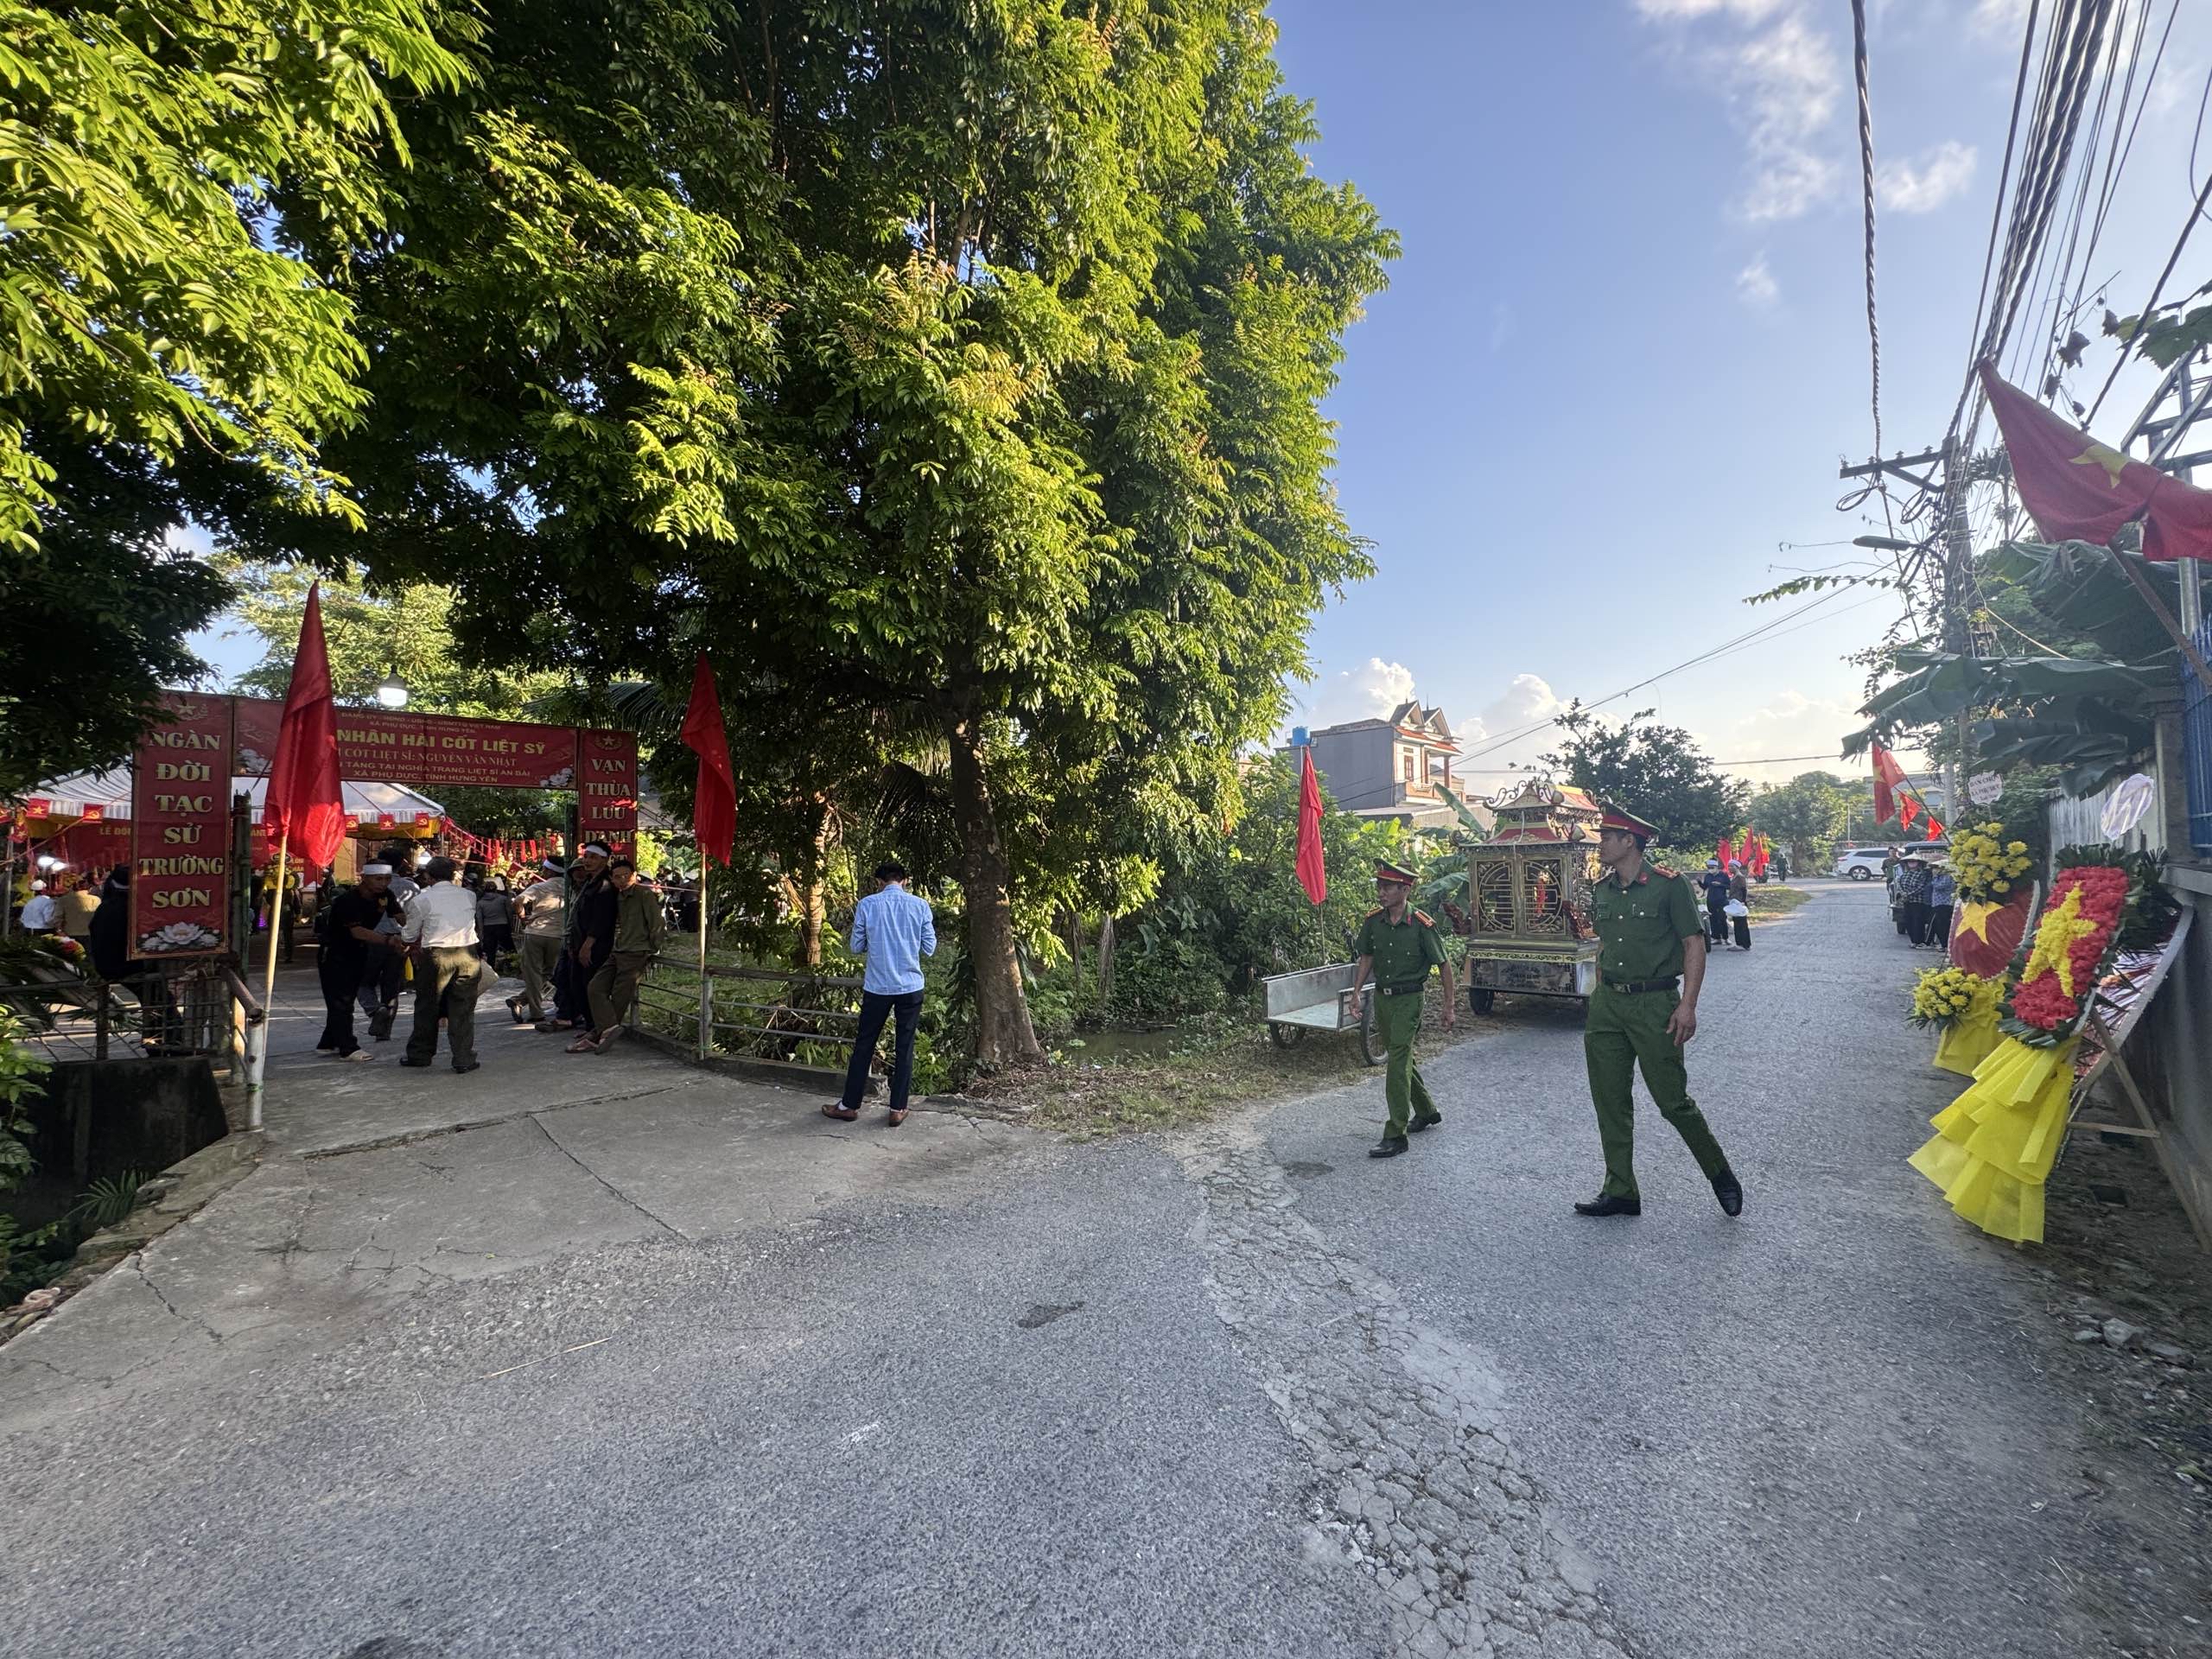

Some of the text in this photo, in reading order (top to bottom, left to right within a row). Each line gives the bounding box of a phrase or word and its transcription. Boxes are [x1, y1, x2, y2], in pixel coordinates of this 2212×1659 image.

[146, 729, 221, 750] NGÀN
[336, 728, 546, 754] NHẬN HÀI CỐT LIỆT SỸ
[346, 747, 372, 759] CỐT
[372, 749, 398, 762] LIỆT
[156, 760, 212, 782] ĐỜI
[345, 760, 375, 769] TÁNG
[380, 763, 395, 772] TẠI
[397, 763, 429, 772] NGHĨA
[591, 759, 626, 774] VẠN
[480, 774, 498, 783] YÊN
[155, 794, 213, 817] TẠC
[592, 804, 626, 820] LƯU
[164, 823, 202, 844] SỬ
[585, 830, 632, 843] DANH
[139, 854, 224, 876] TRƯỜNG
[152, 887, 212, 908] SƠN
